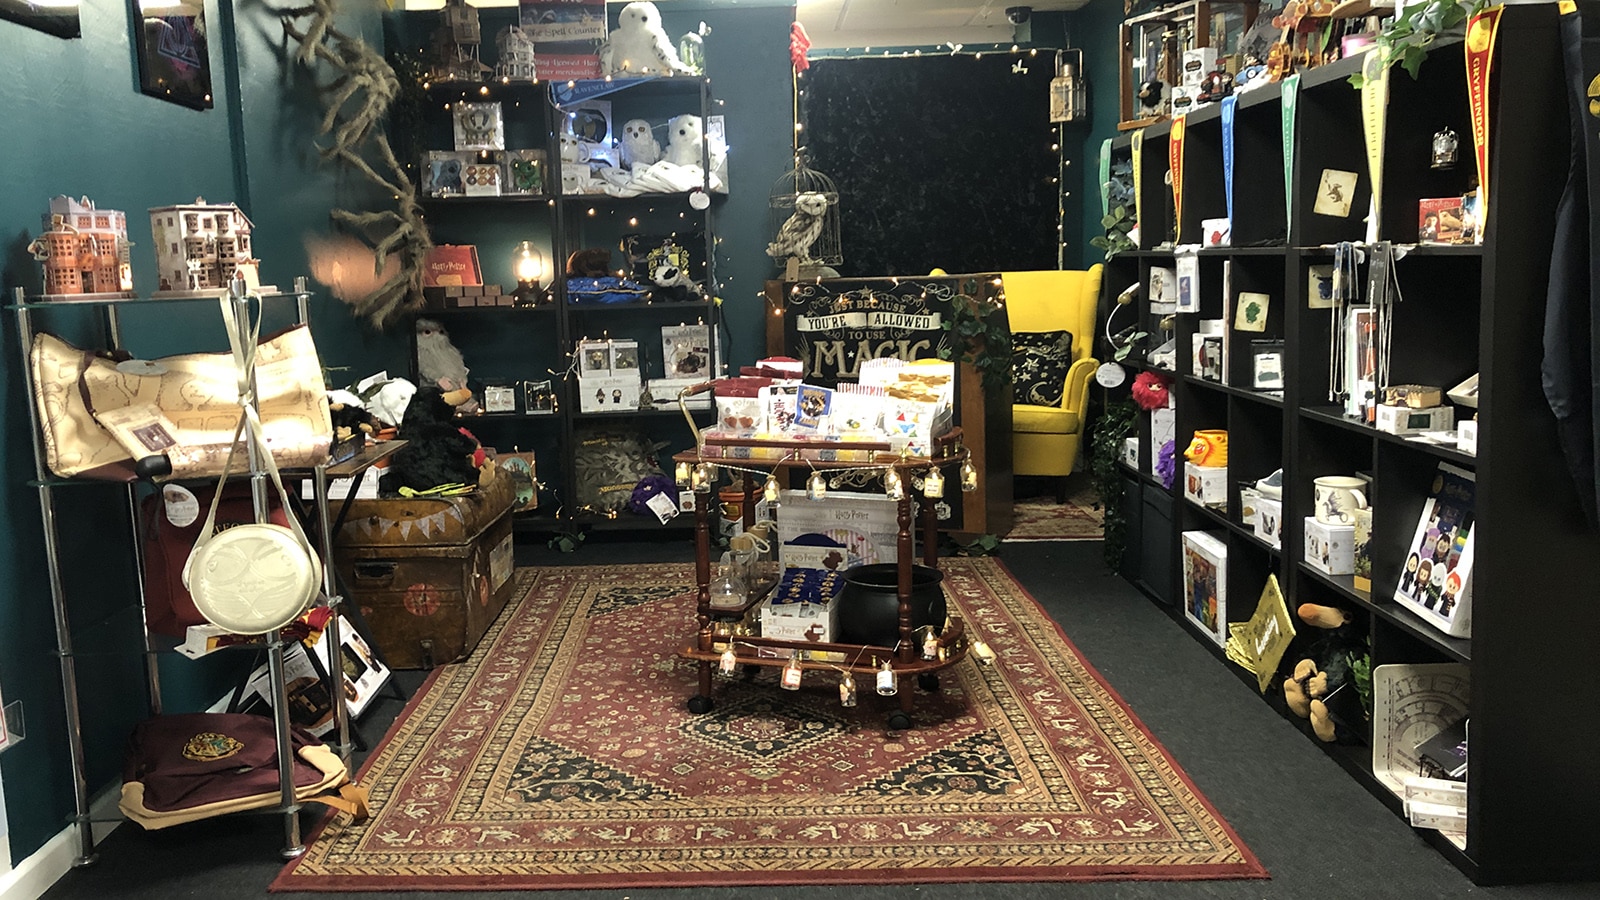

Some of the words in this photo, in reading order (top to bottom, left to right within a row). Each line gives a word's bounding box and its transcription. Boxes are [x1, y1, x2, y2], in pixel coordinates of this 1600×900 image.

[545, 28, 566, 38] Spell
[568, 26, 601, 36] Counter
[1472, 57, 1485, 147] GRYFFINDOR
[857, 299, 907, 314] BECAUSE
[808, 315, 846, 330] YOU'RE
[874, 313, 930, 329] ALLOWED
[848, 331, 863, 340] TO
[866, 331, 886, 340] USE
[835, 510, 851, 520] Harry
[851, 510, 870, 520] Potter
